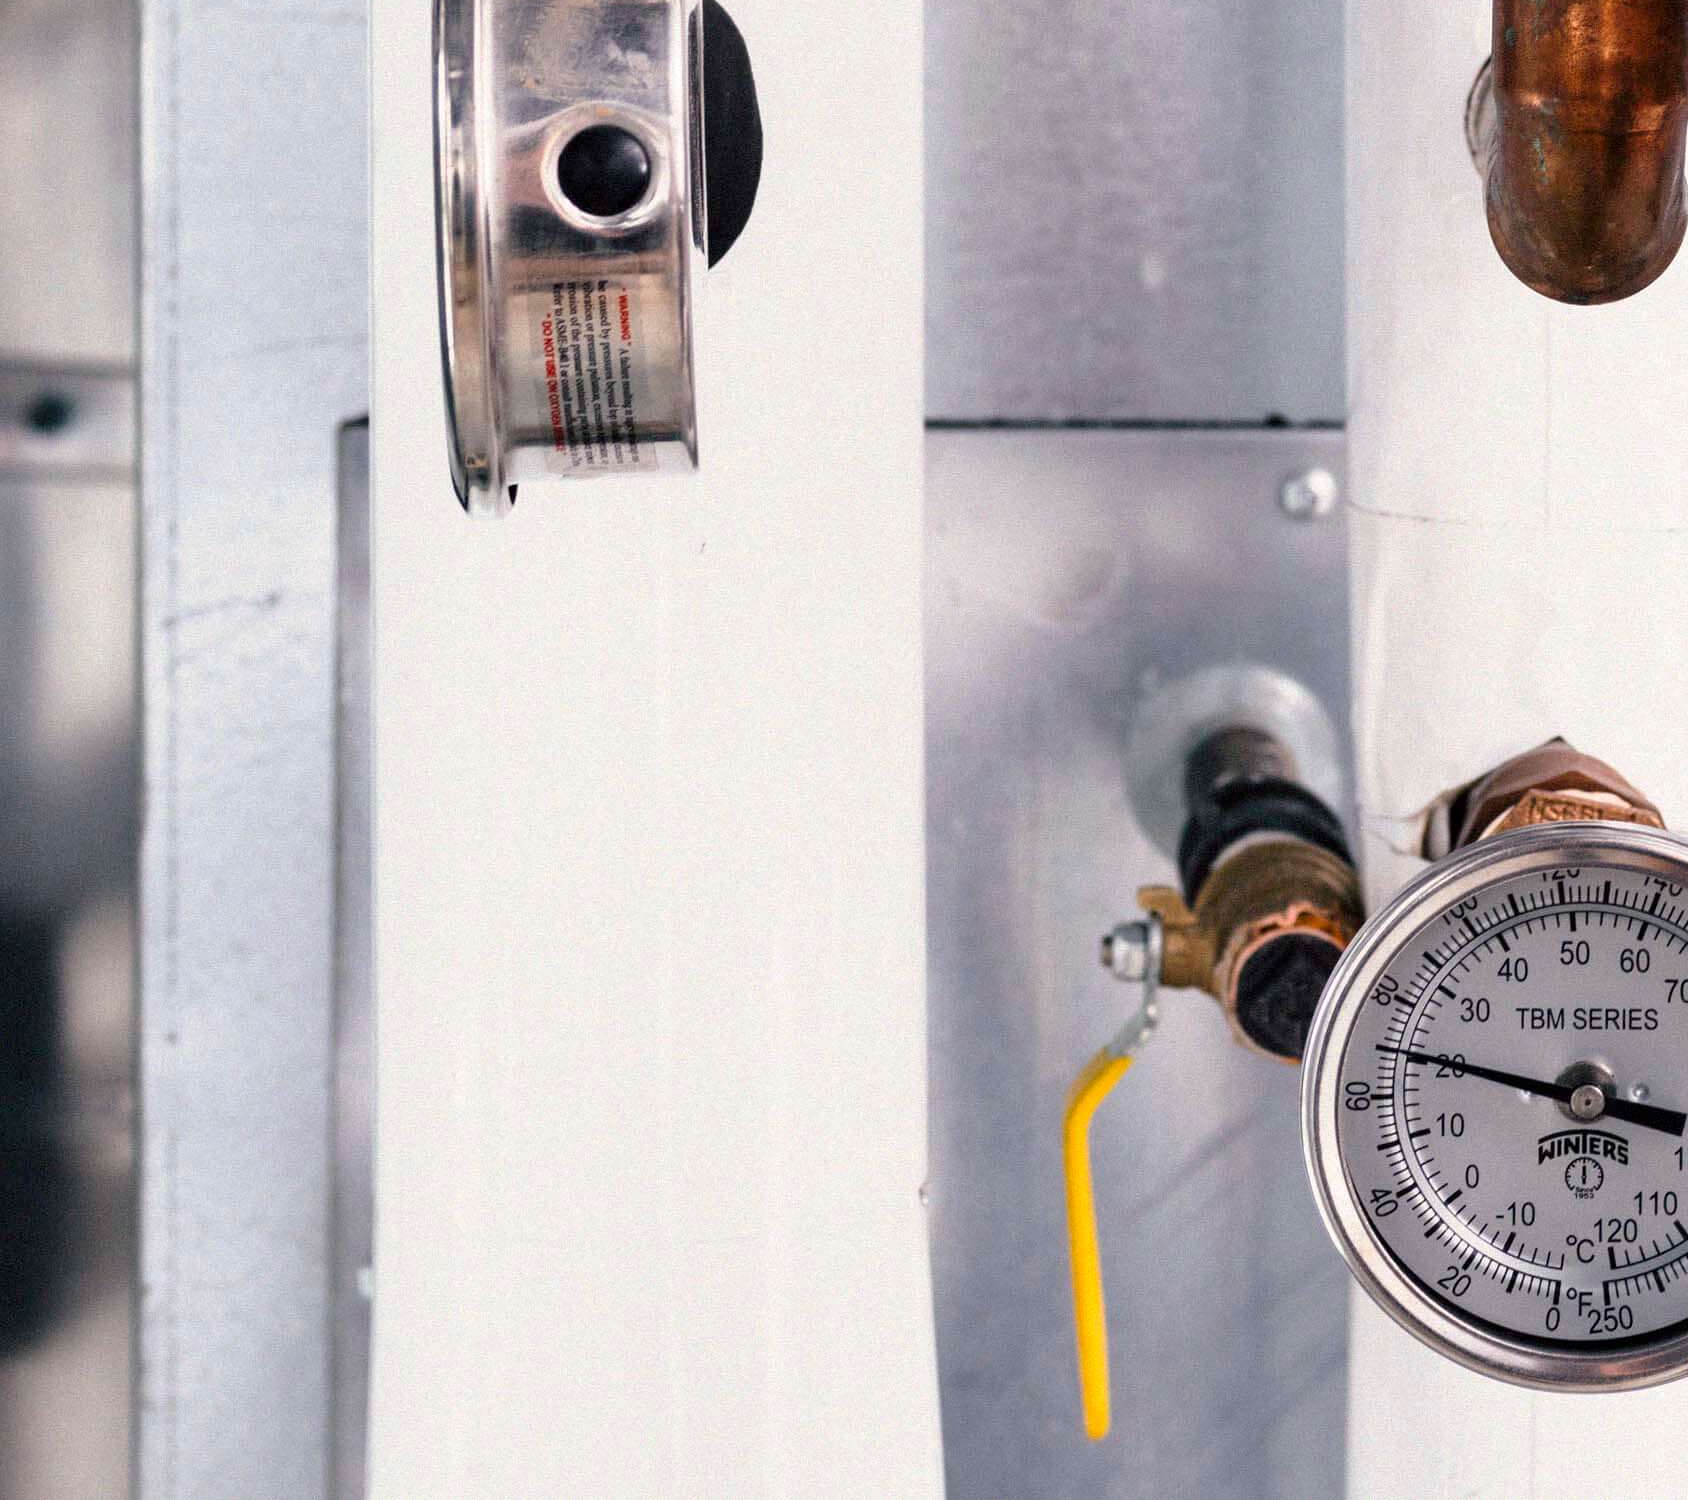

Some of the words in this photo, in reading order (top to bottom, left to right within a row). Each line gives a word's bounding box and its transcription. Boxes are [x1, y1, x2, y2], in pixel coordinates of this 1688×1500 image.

[618, 295, 631, 341] WARNING
[1497, 957, 1528, 983] 40
[1620, 949, 1650, 973] 60
[1560, 942, 1590, 966] 50
[1459, 998, 1491, 1023] 30
[1516, 1007, 1566, 1030] TBM
[1573, 1007, 1659, 1031] SERIES
[1344, 1080, 1371, 1110] 60
[1437, 1113, 1465, 1138] 10
[1537, 1130, 1629, 1166] WINTERS
[1464, 1165, 1479, 1189] 0
[1370, 1187, 1398, 1218] 40
[1495, 1202, 1536, 1227] -10
[1634, 1192, 1679, 1217] 110
[1594, 1218, 1638, 1243] 120
[1437, 1266, 1471, 1298] 20
[1545, 1307, 1561, 1332] 0
[1588, 1306, 1634, 1334] 250
